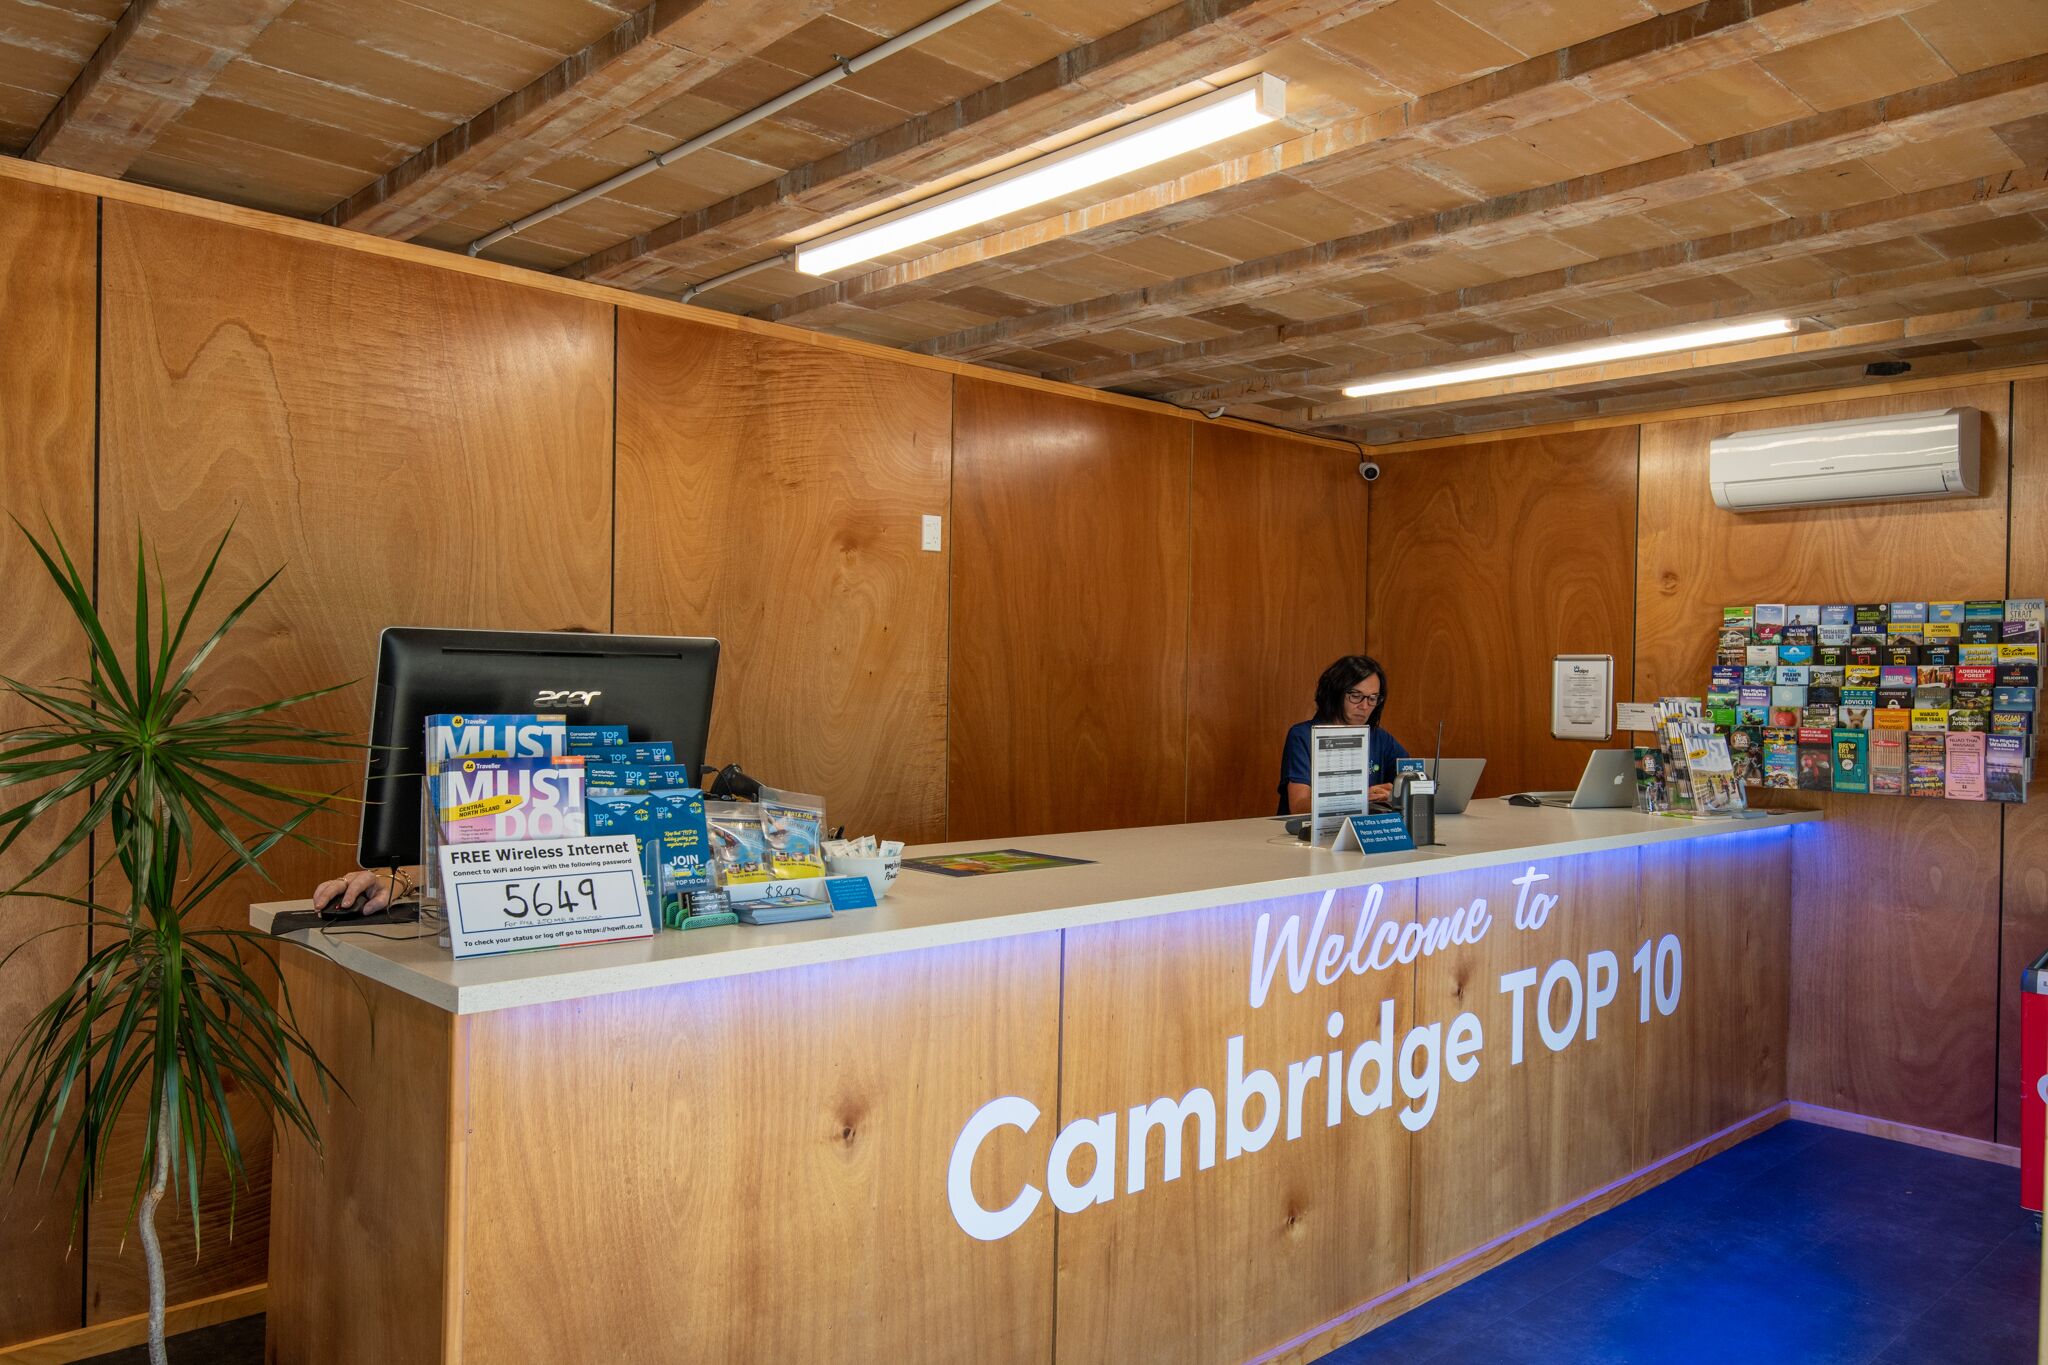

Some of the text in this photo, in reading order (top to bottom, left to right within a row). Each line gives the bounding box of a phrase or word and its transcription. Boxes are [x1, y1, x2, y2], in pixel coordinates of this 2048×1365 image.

[2010, 602, 2042, 610] THE COOK
[2010, 610, 2032, 618] STRAIT
[533, 690, 602, 708] acer
[1660, 702, 1702, 718] MUST
[602, 731, 619, 739] TOP
[1675, 722, 1716, 734] MUST
[437, 725, 566, 758] MUST
[1687, 738, 1727, 754] MUST
[610, 754, 627, 762] TOP
[652, 748, 666, 756] TOP
[625, 771, 642, 779] TOP
[449, 769, 584, 809] MUST
[459, 803, 485, 812] CENTRAL
[459, 804, 501, 818] NORTH ISLAND
[783, 810, 813, 820] PORTA-PAK
[1372, 828, 1383, 836] press
[451, 841, 629, 864] FREE Wireless Internet
[492, 866, 508, 874] WiFi
[523, 864, 541, 873] login
[558, 861, 569, 869] the
[571, 859, 601, 869] following
[602, 858, 632, 867] password
[669, 854, 700, 867] JOIN
[503, 878, 597, 918] 5649
[474, 937, 494, 946] check
[495, 936, 511, 944] your
[543, 931, 554, 940] log
[583, 923, 643, 934] https://hqwifi.co.nz
[1249, 865, 1559, 1009] Welcome to
[946, 933, 1684, 1242] Cambridge TOP 10
